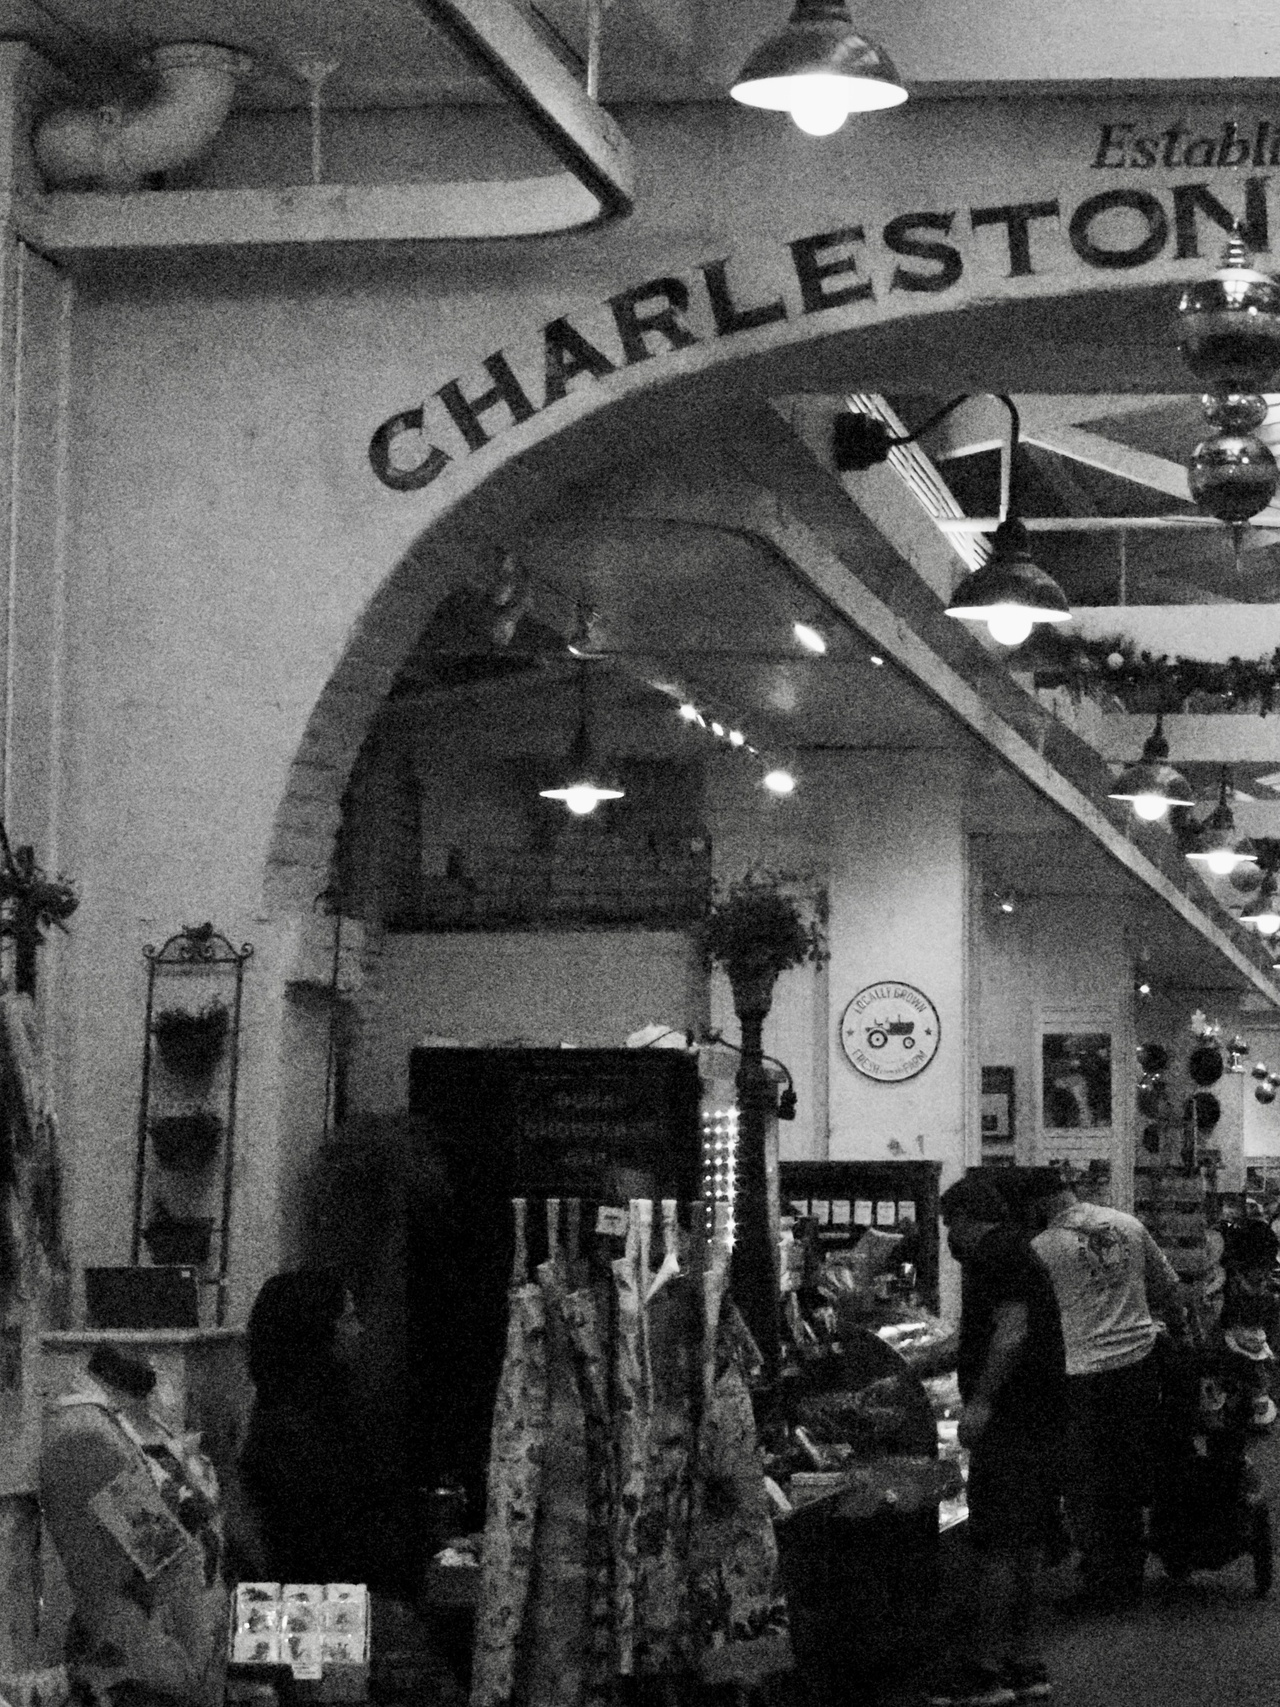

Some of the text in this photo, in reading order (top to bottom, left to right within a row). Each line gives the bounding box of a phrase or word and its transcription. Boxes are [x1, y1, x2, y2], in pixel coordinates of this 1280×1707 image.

[367, 174, 1273, 492] CHARLESTON
[852, 986, 927, 1015] LOCALLY GROWN
